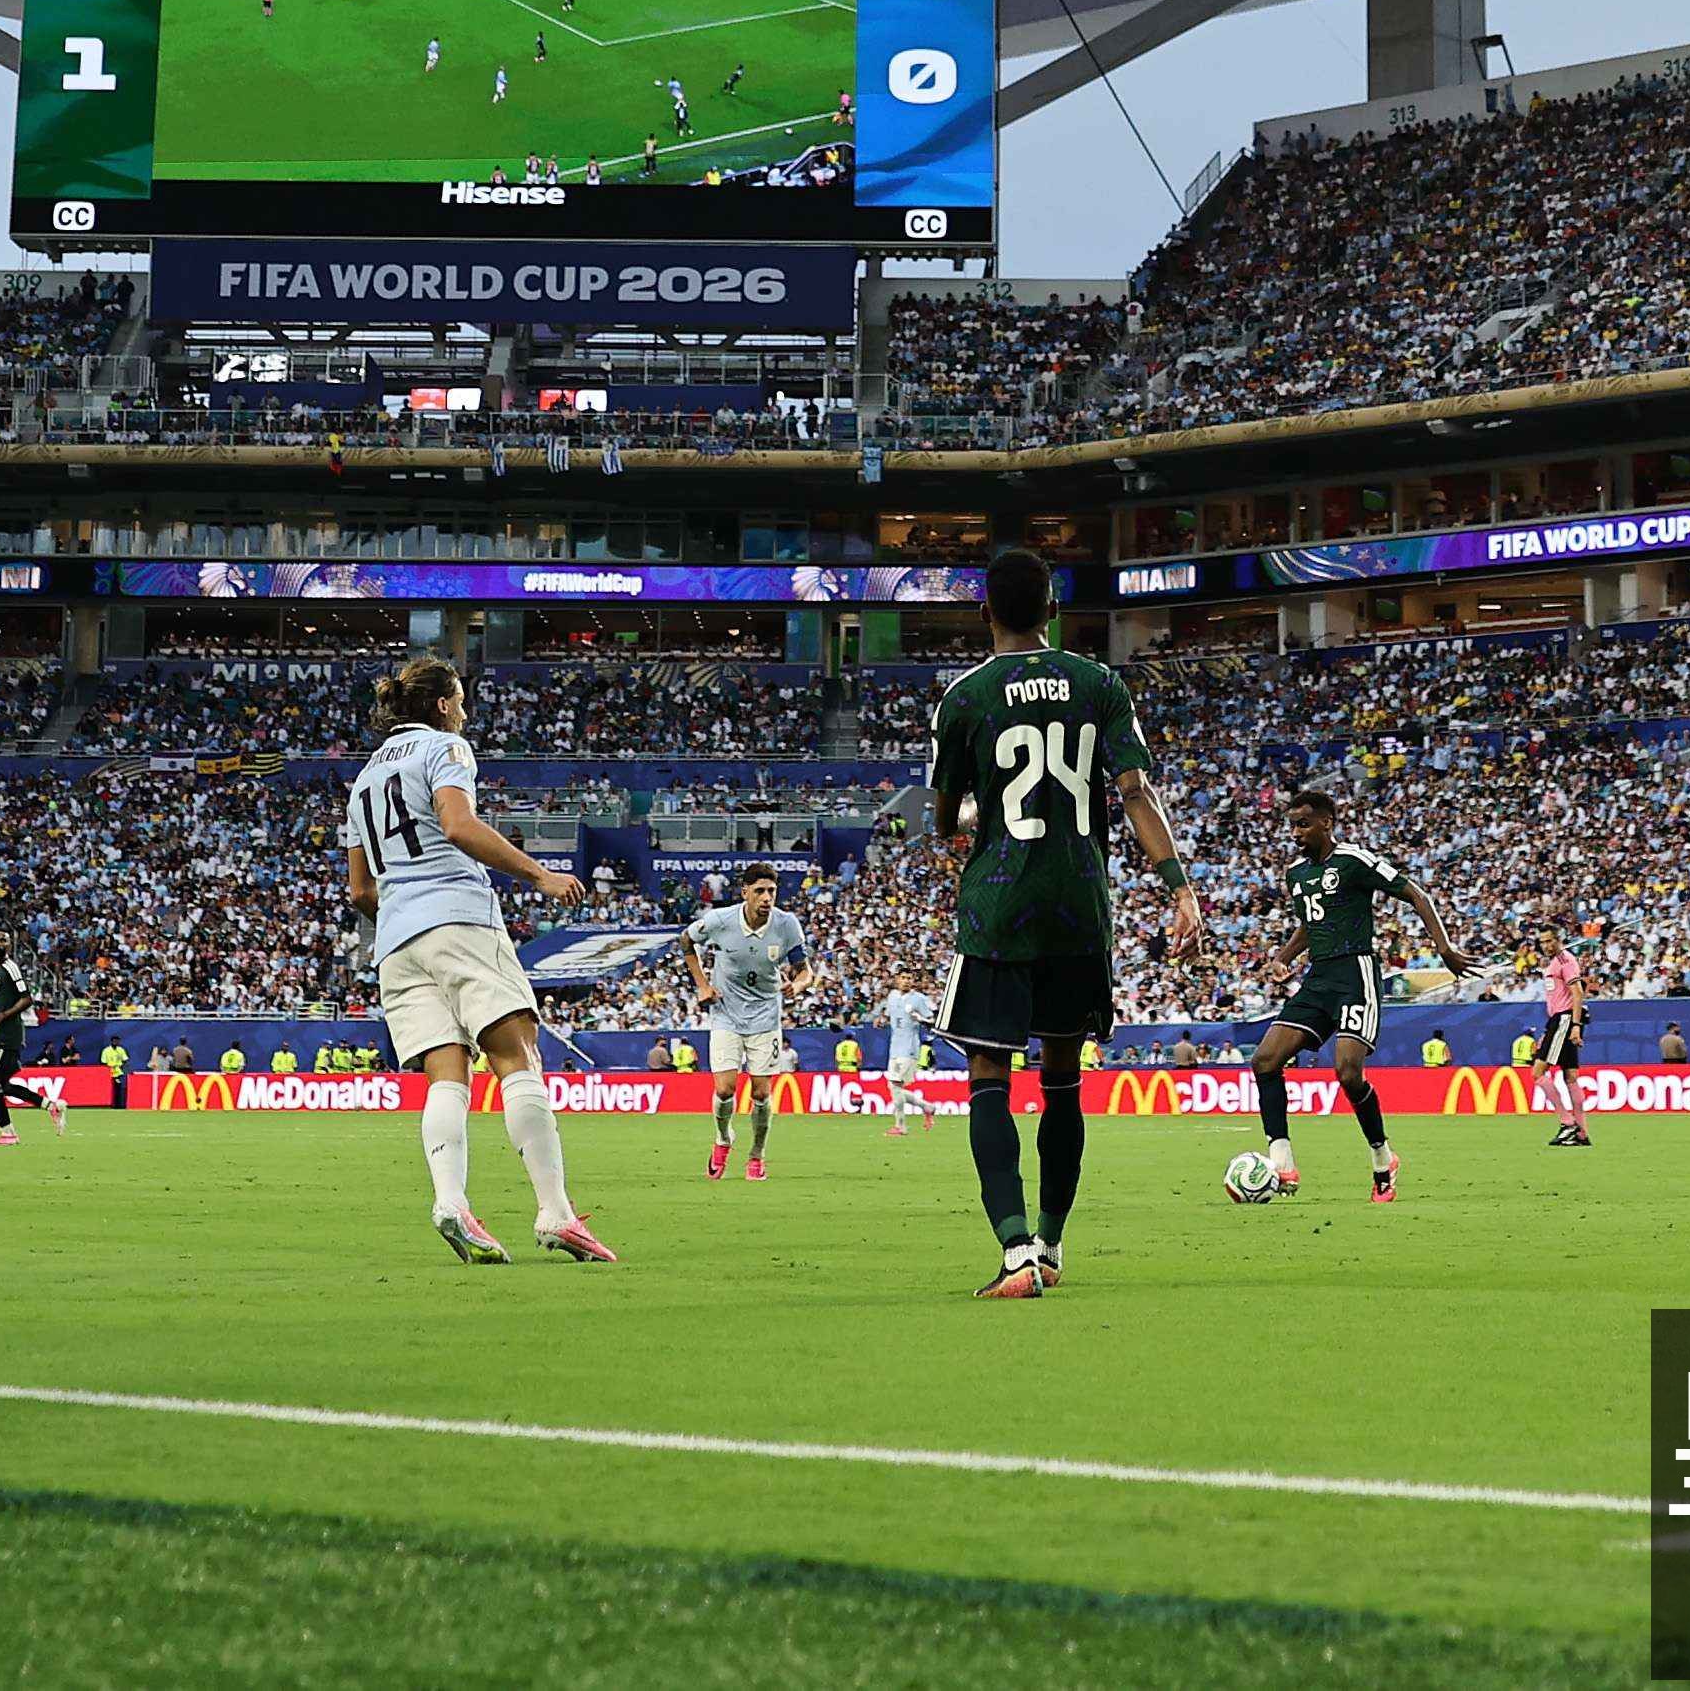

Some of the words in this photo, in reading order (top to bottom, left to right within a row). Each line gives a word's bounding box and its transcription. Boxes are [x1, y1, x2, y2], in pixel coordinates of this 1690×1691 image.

[62, 36, 116, 92] 1
[1389, 103, 1418, 126] 313
[441, 181, 565, 207] Hisense
[58, 206, 91, 228] CC
[910, 214, 944, 236] CC
[3, 273, 43, 295] 309
[220, 262, 319, 301] FIFA
[329, 263, 505, 302] WORLD
[514, 265, 610, 303] CUP
[618, 267, 787, 303] 2026
[1487, 529, 1543, 561] FIFA
[1546, 518, 1639, 555] WORLD
[523, 571, 643, 596] #FIFAWorldCup
[1118, 565, 1197, 595] MIAMI
[1005, 676, 1070, 706] MOTEB
[995, 721, 1097, 840] 24
[359, 771, 425, 876] 14
[652, 860, 683, 873] FIFA
[685, 860, 732, 873] WORLD
[1302, 892, 1325, 923] 15
[745, 970, 757, 987] 8
[1339, 1004, 1365, 1031] 15
[771, 1037, 781, 1061] 8
[236, 1075, 401, 1111] McDonald's
